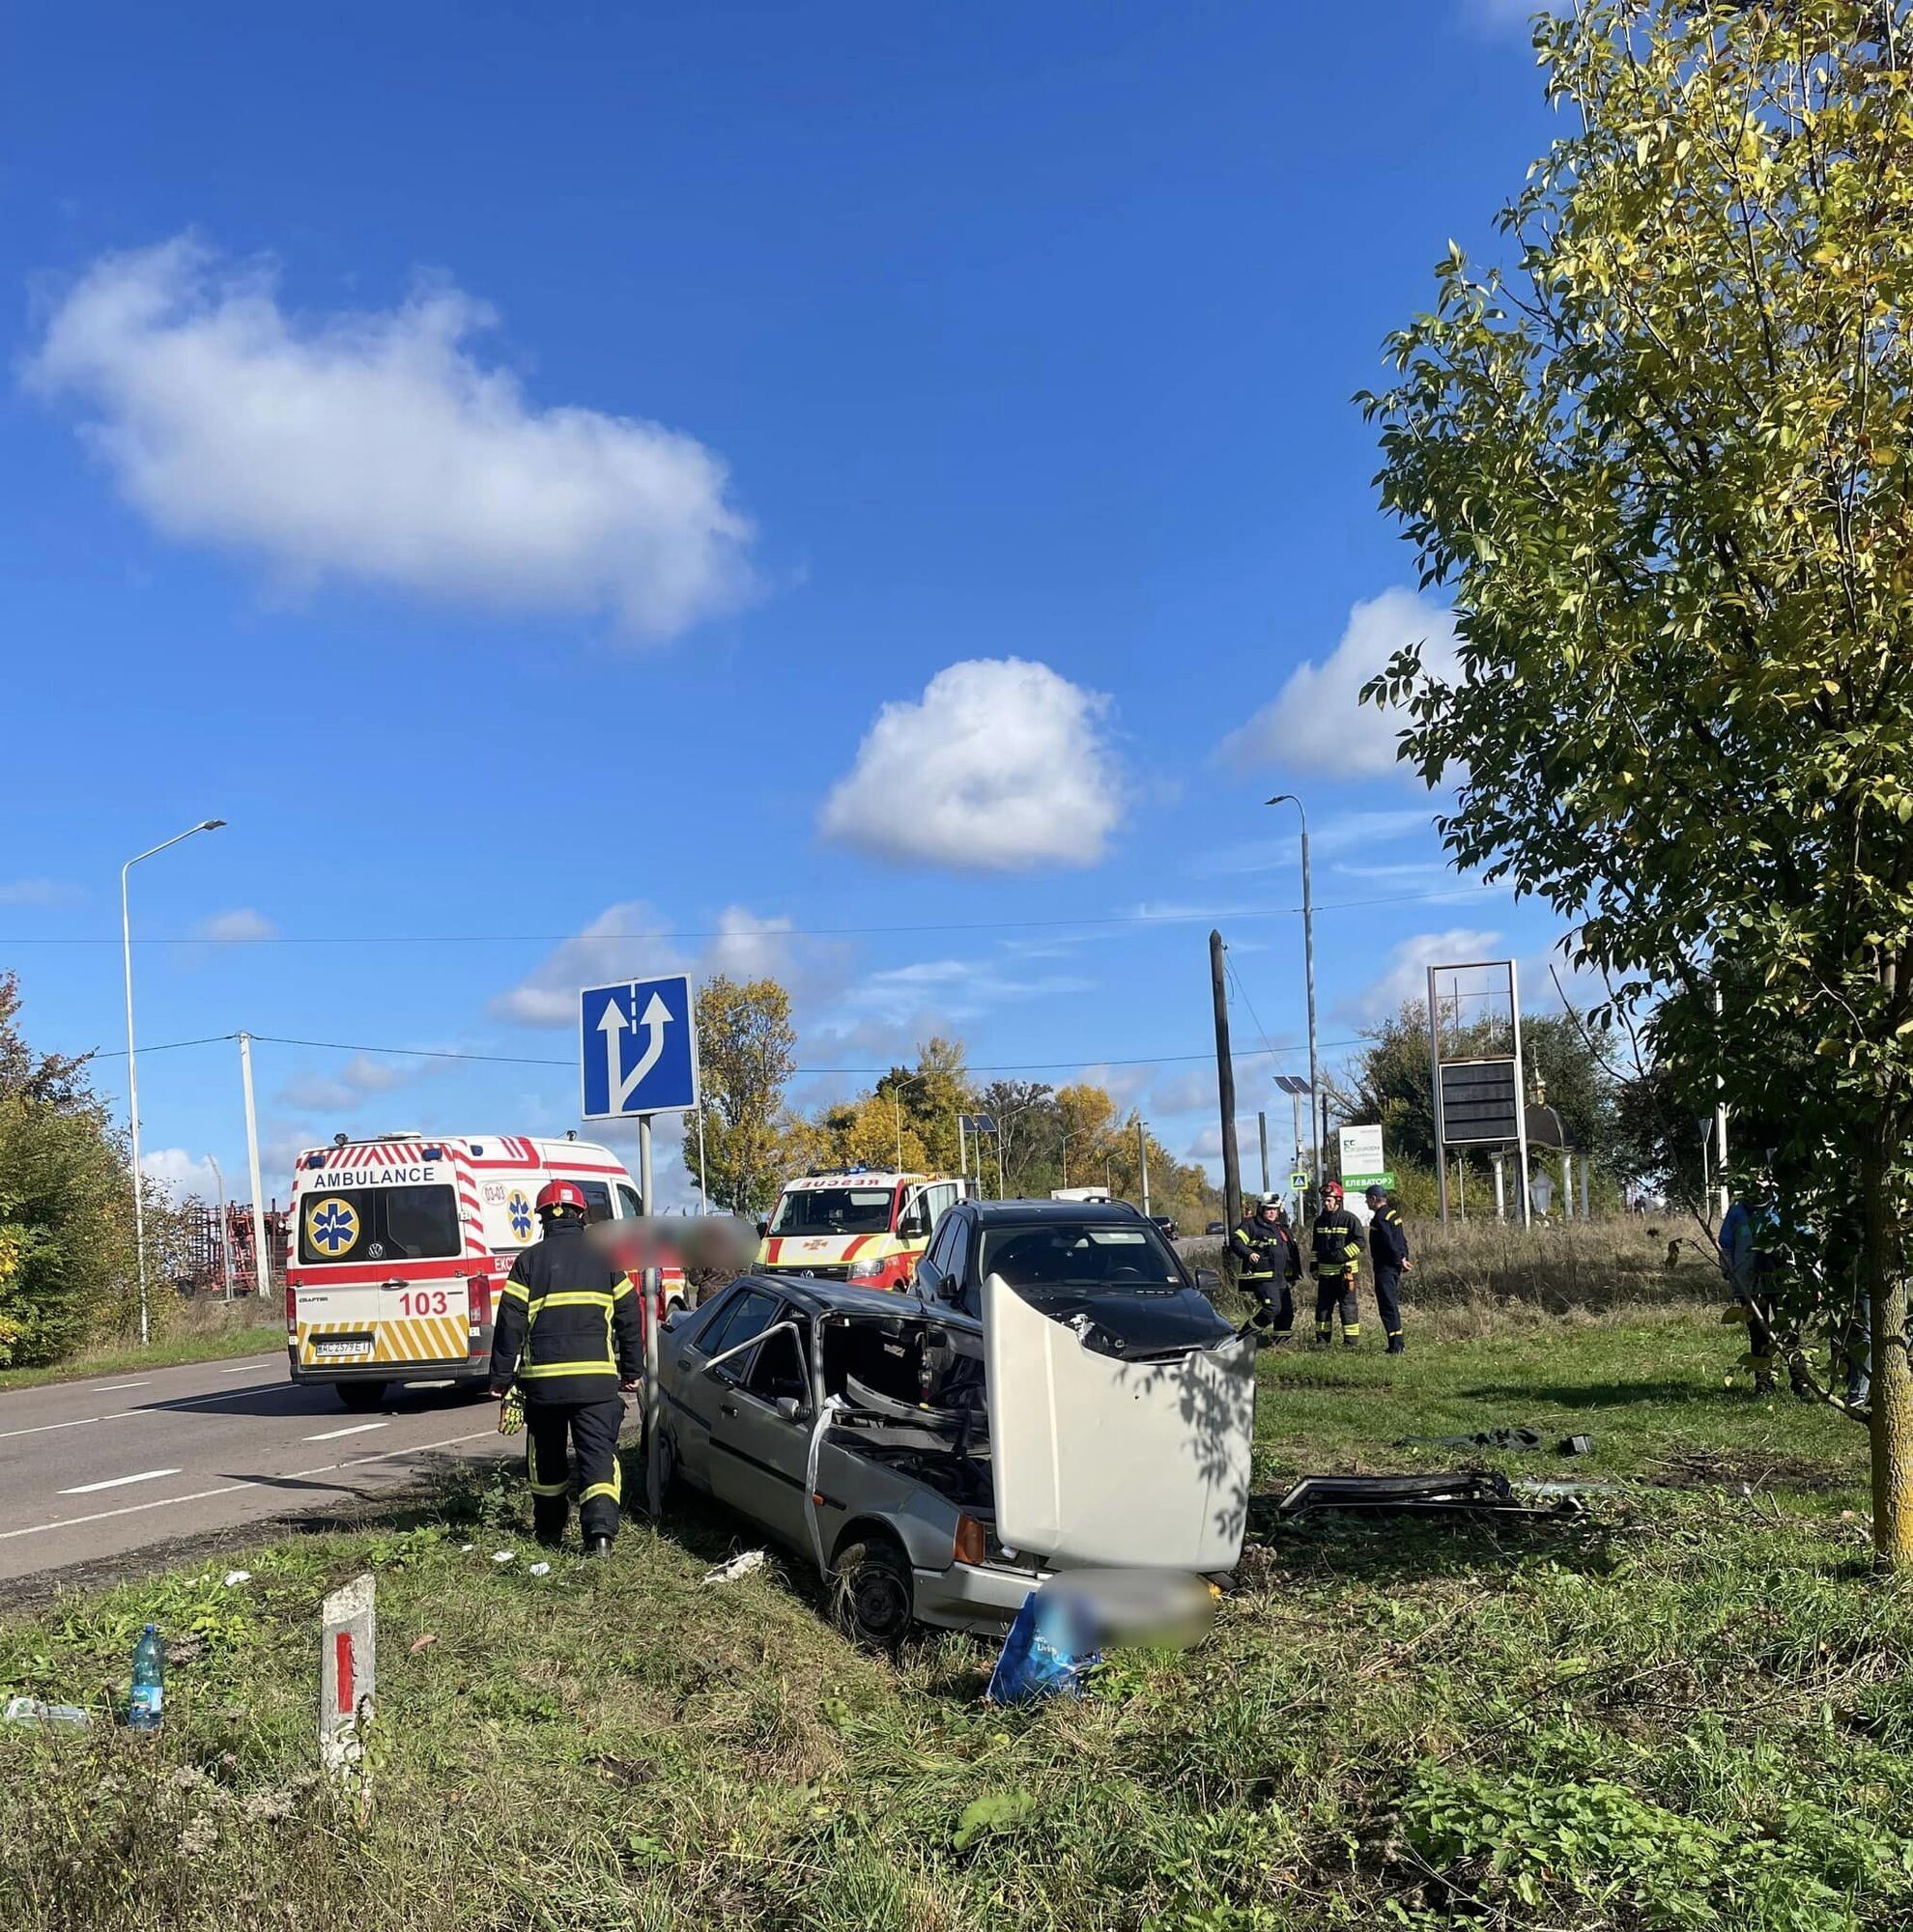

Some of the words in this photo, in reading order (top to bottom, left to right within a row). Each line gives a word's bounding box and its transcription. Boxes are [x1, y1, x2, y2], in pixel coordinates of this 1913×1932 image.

[314, 1167, 435, 1188] AMBULANCE
[1345, 1177, 1387, 1187] ЕЛЕВАТОР
[399, 1291, 447, 1316] 103
